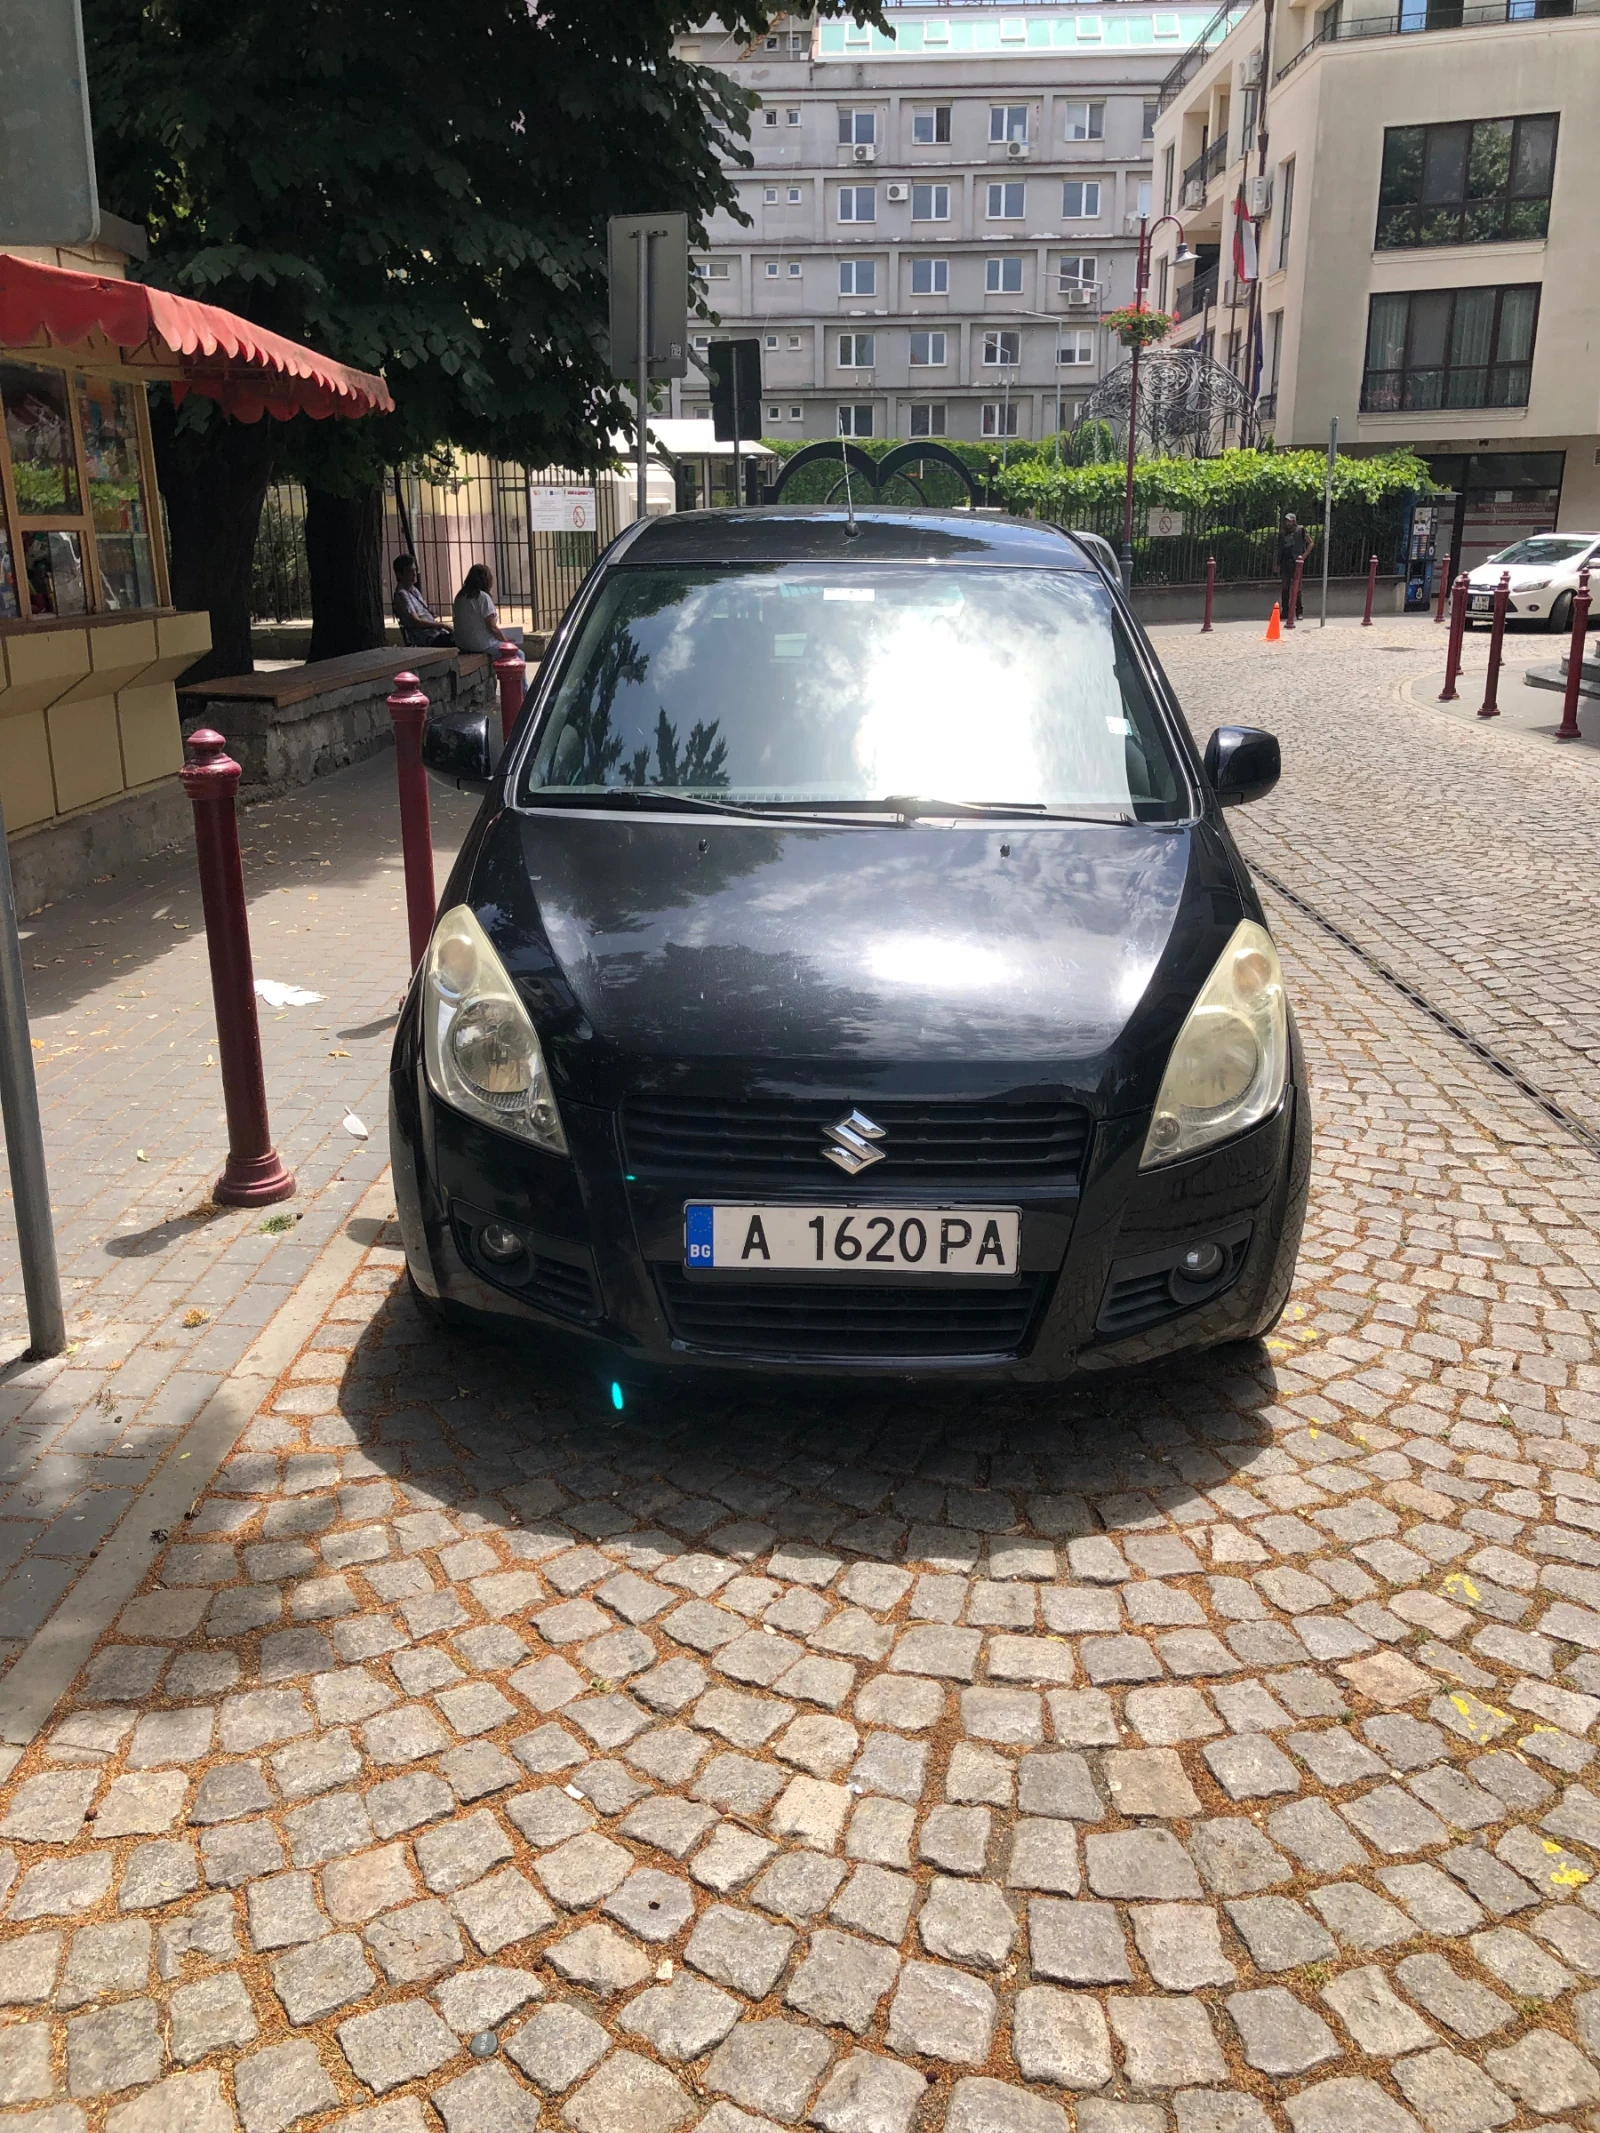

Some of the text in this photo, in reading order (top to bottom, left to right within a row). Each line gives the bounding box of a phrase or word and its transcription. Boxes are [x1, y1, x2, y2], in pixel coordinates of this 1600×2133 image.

[690, 1244, 711, 1258] BG
[741, 1214, 1006, 1266] A 1620 PA
